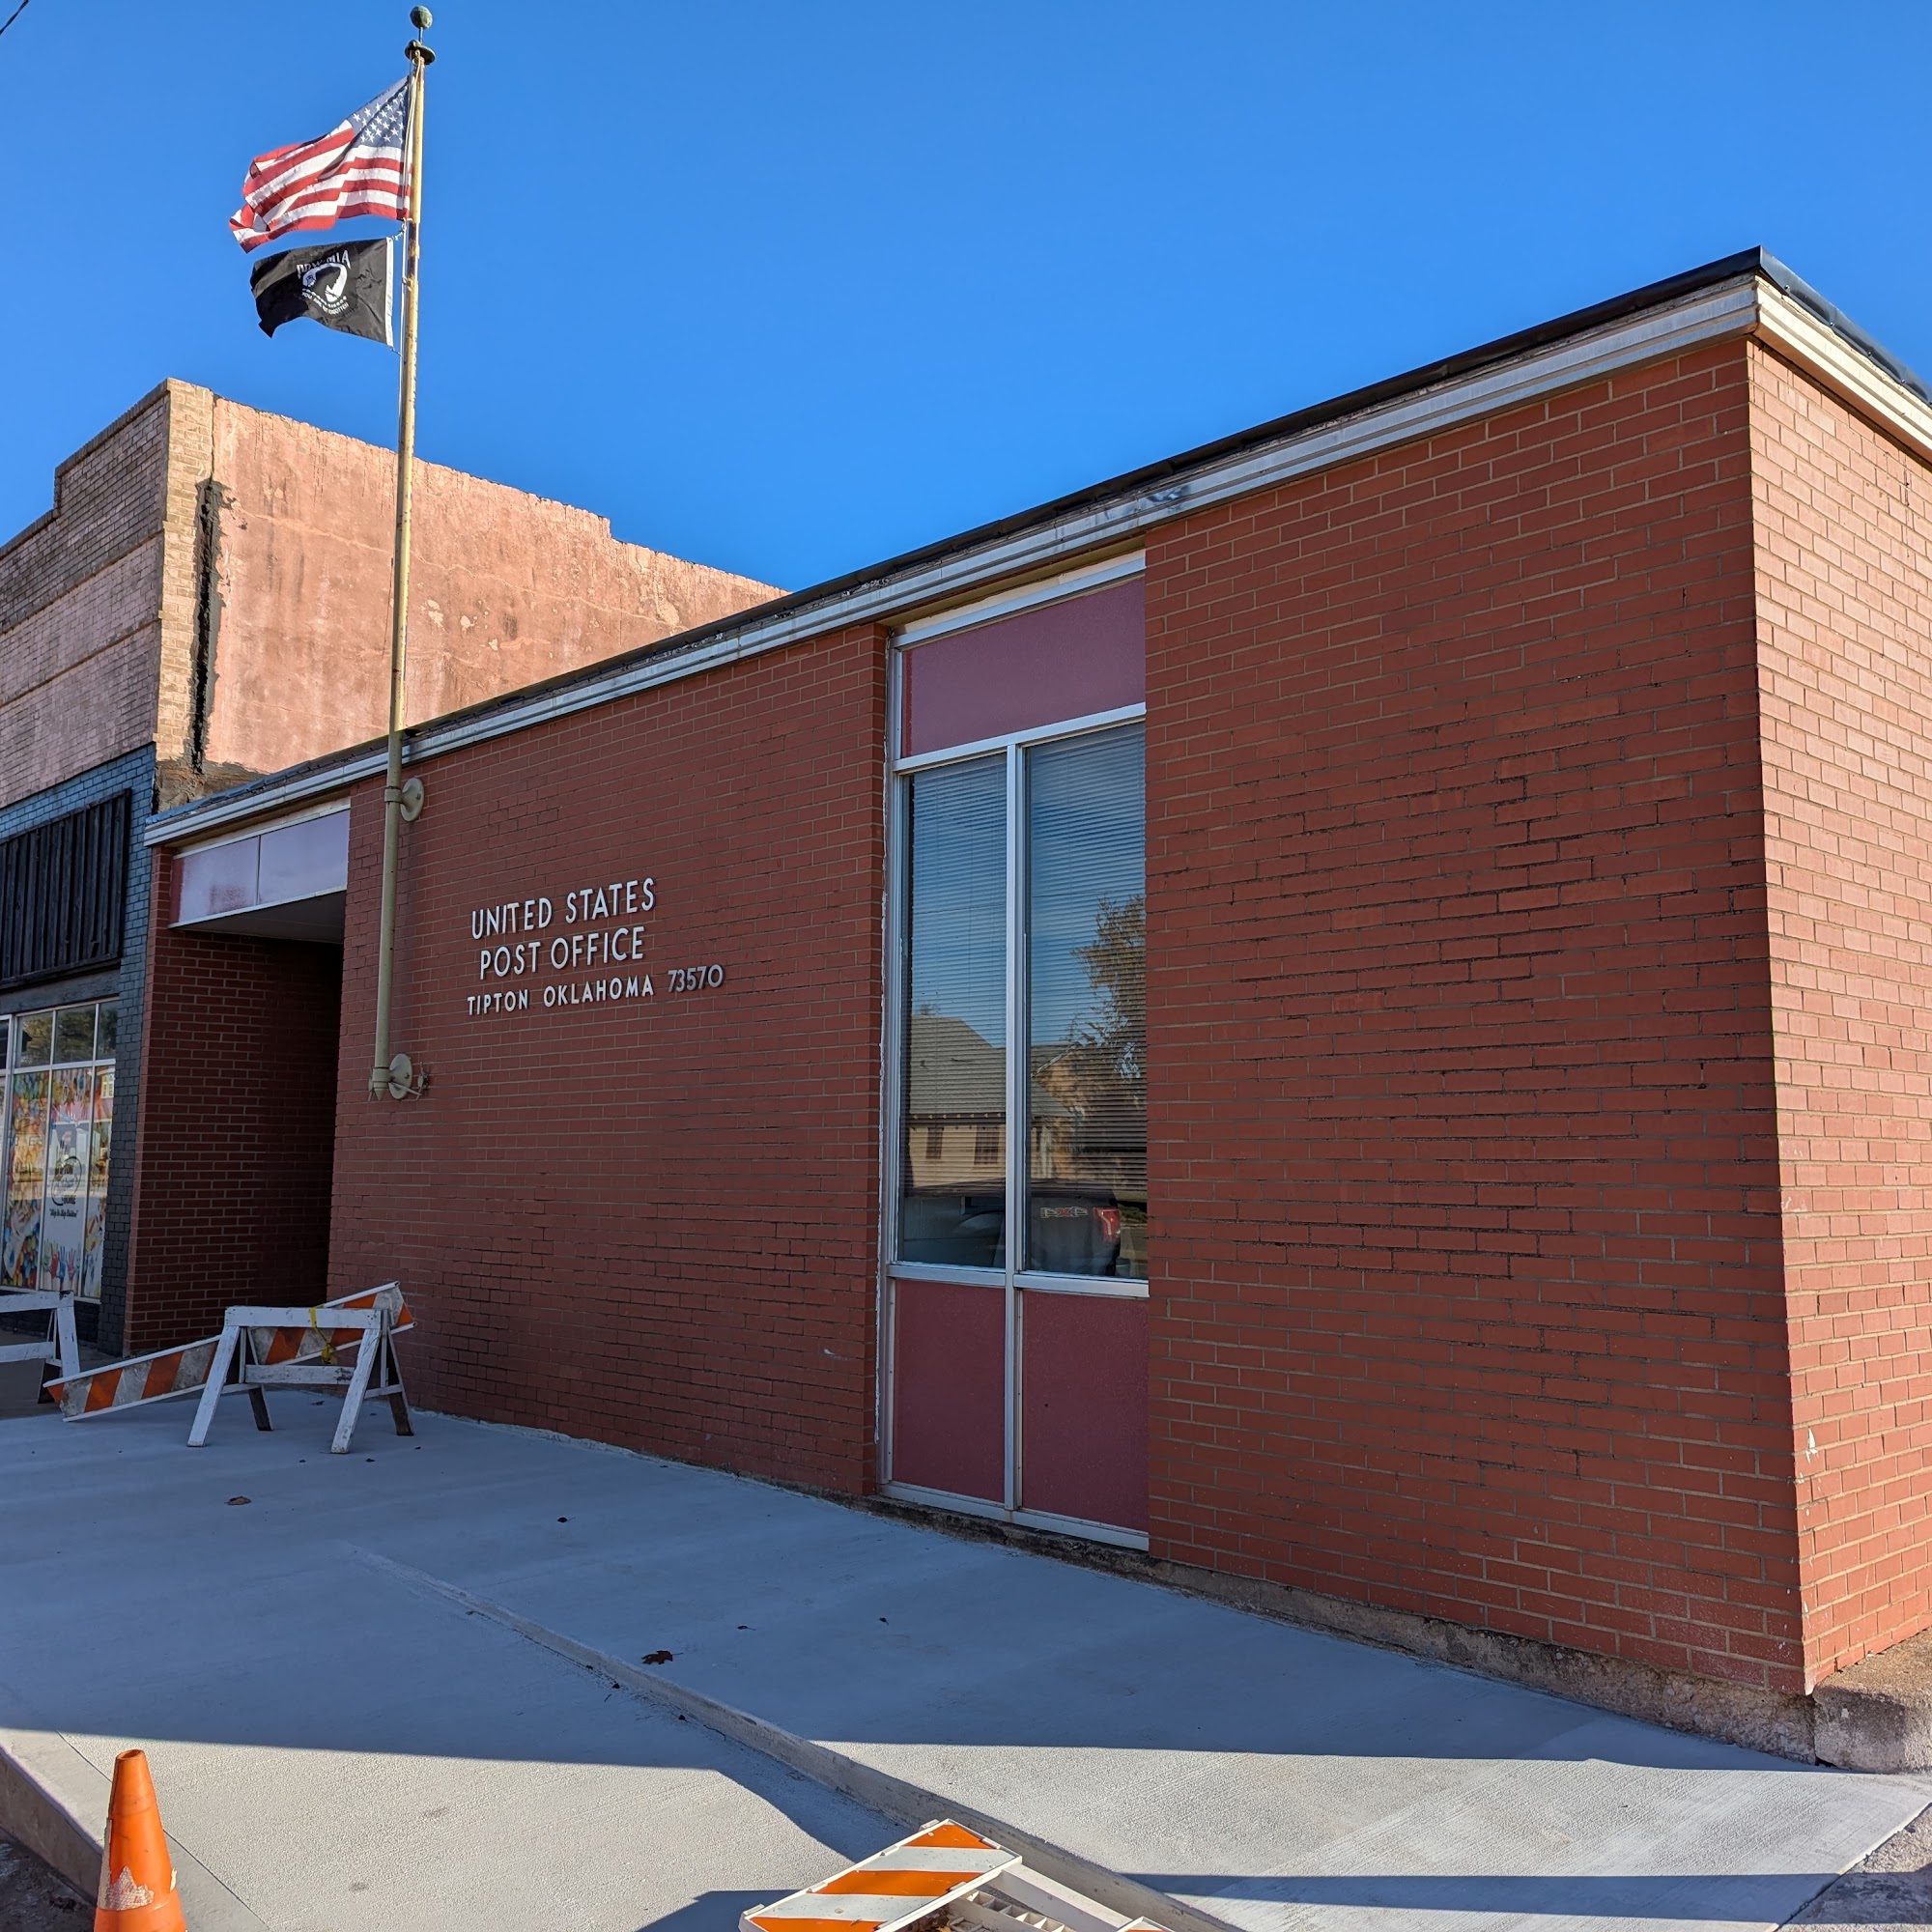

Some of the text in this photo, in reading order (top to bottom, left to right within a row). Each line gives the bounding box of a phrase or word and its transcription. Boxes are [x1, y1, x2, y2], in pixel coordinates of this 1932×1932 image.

[471, 877, 656, 940] UNITED STATES
[480, 925, 645, 980] POST OFFICE
[467, 964, 724, 1016] TIPTON OKLAHOMA 73570
